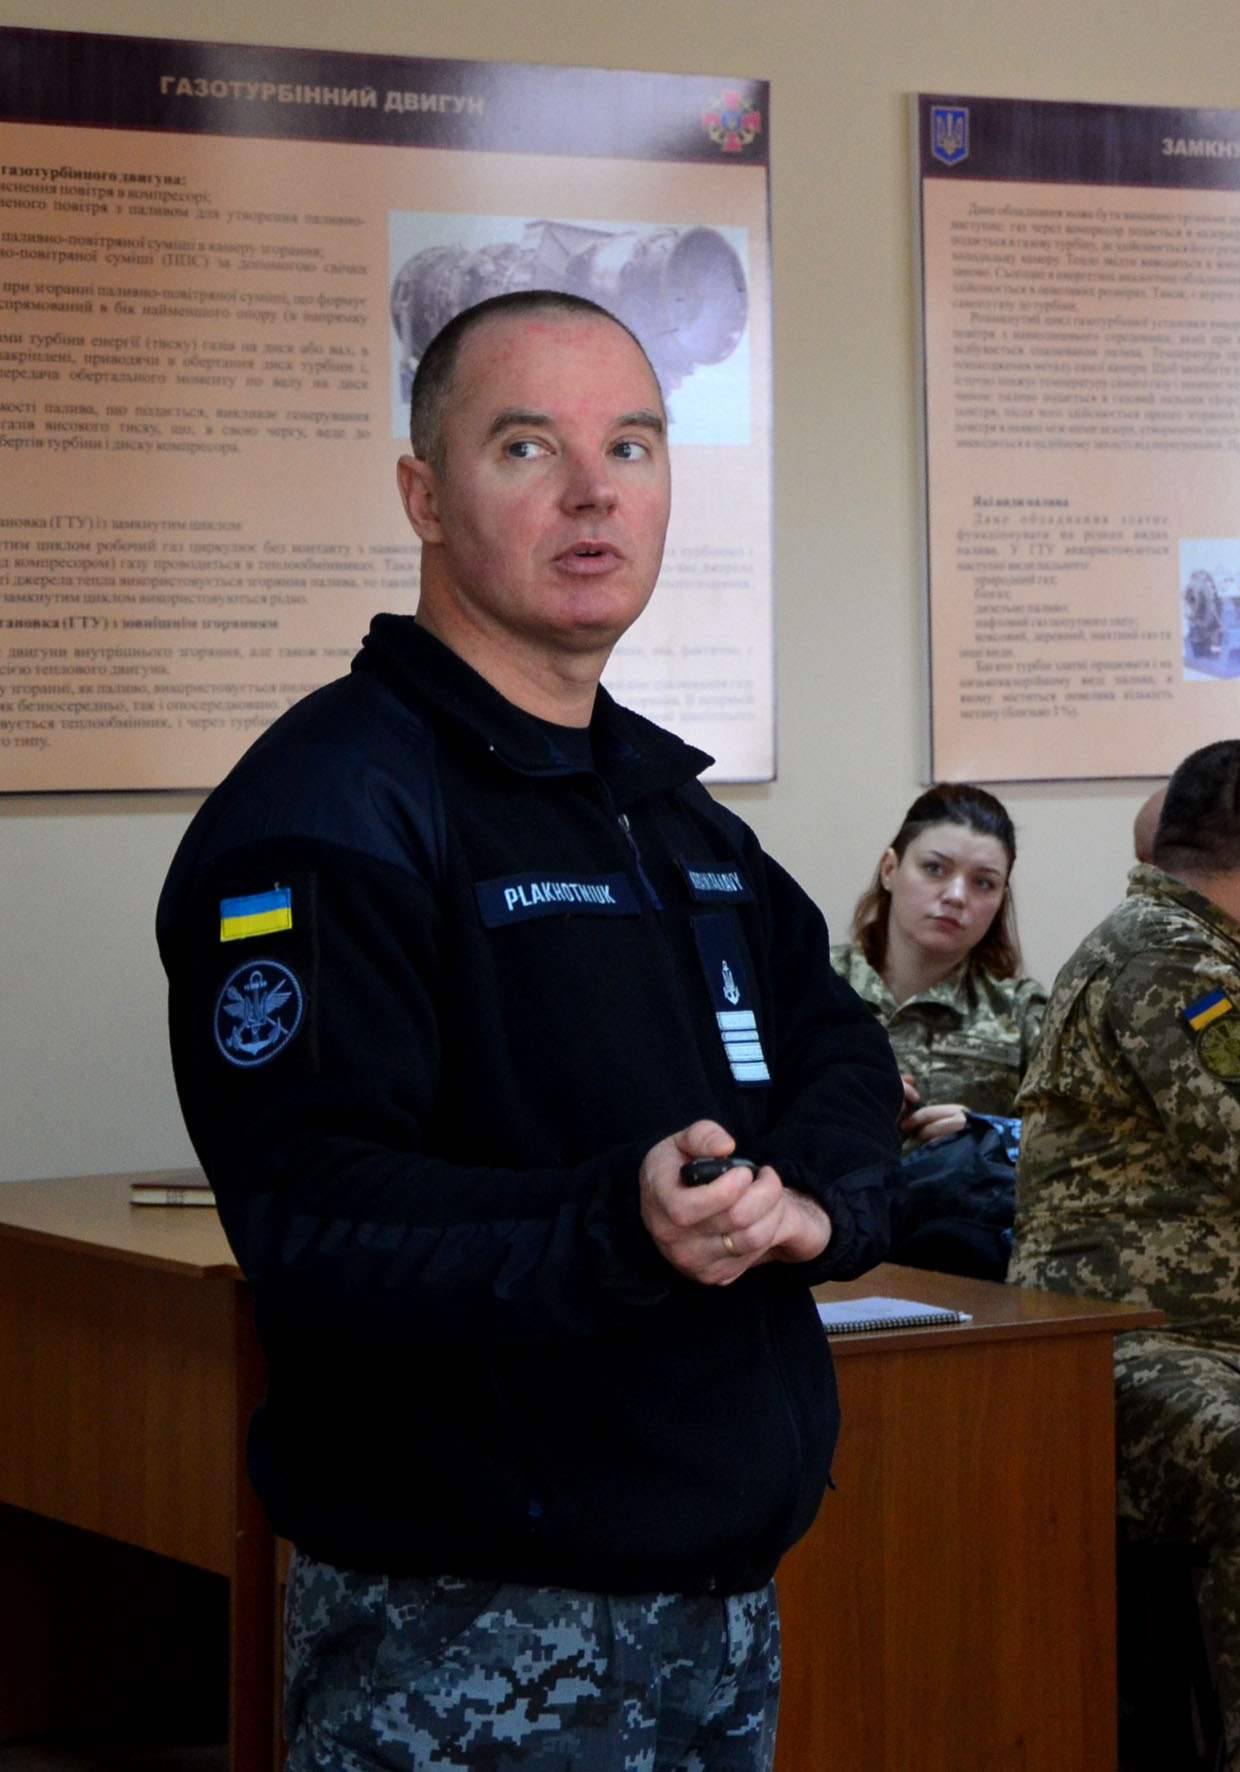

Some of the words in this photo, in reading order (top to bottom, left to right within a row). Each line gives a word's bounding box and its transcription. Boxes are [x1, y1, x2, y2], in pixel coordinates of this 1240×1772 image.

[159, 75, 377, 110] ГАЗОТУРБІННИЙ
[383, 90, 485, 115] ДВИГУН
[1, 163, 118, 183] газотурбінного
[3, 283, 30, 295] при
[503, 881, 617, 911] PLAKHOTNIUK
